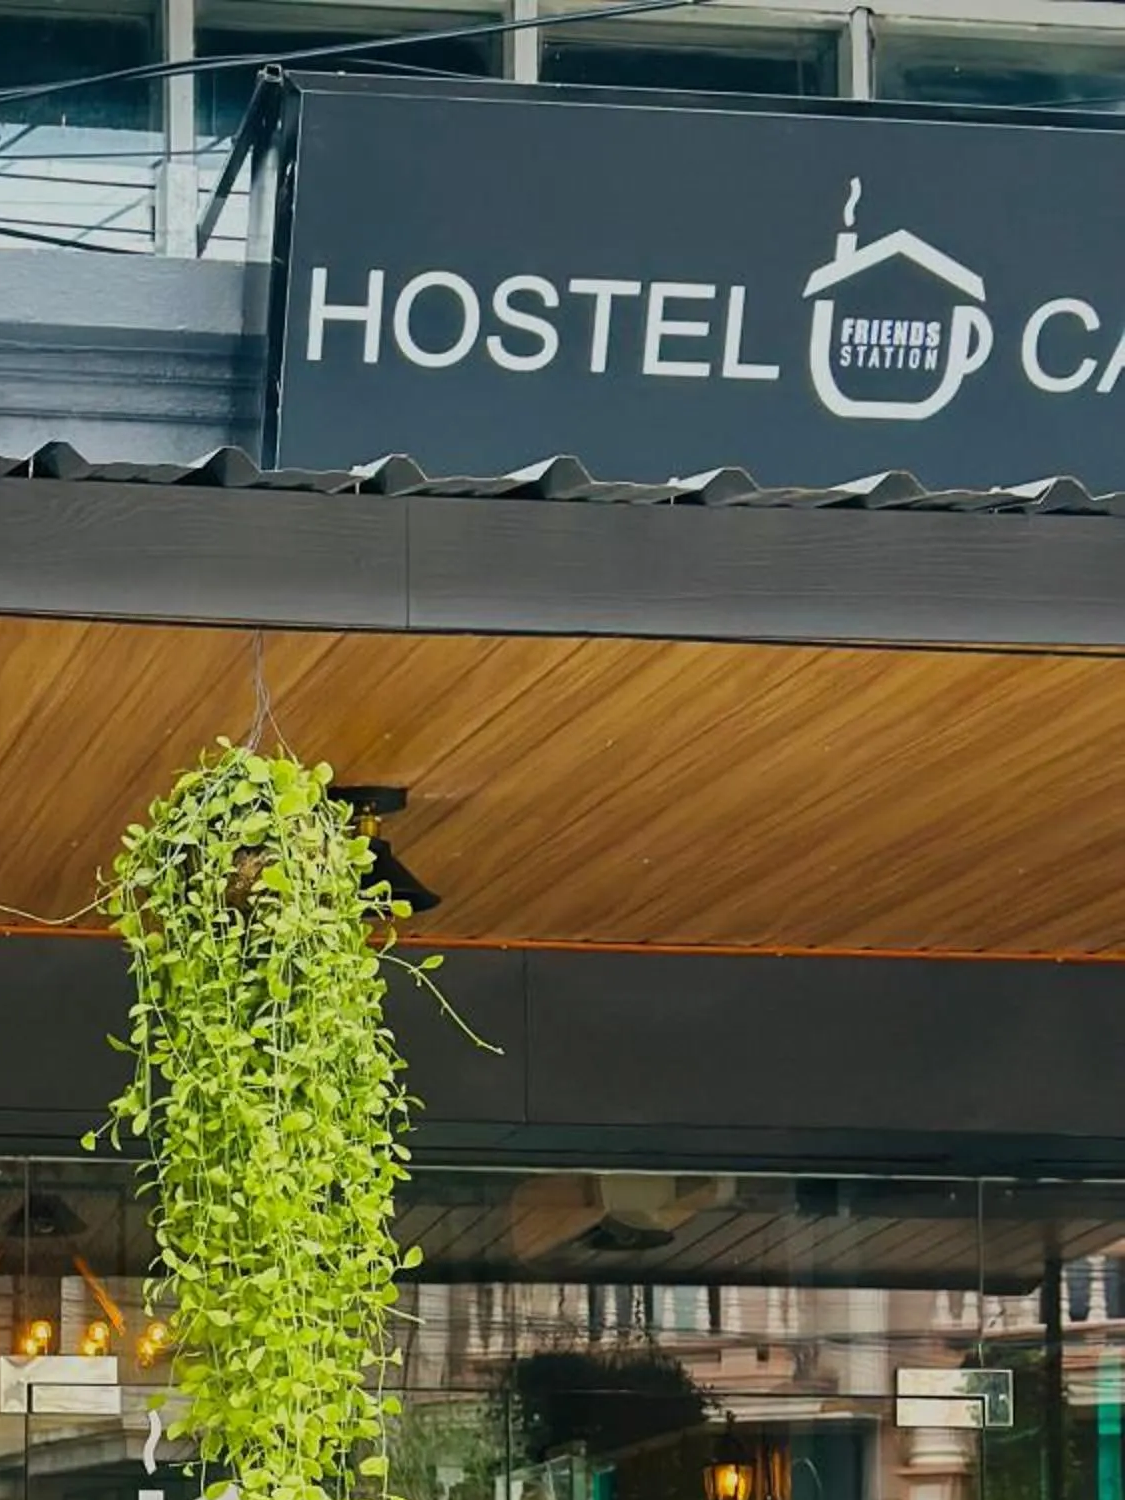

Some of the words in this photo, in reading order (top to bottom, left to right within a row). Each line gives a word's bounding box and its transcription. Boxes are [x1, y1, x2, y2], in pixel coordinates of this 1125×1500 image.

[306, 267, 781, 380] HOSTEL
[840, 317, 942, 347] FRIENDS
[839, 345, 938, 370] STATION
